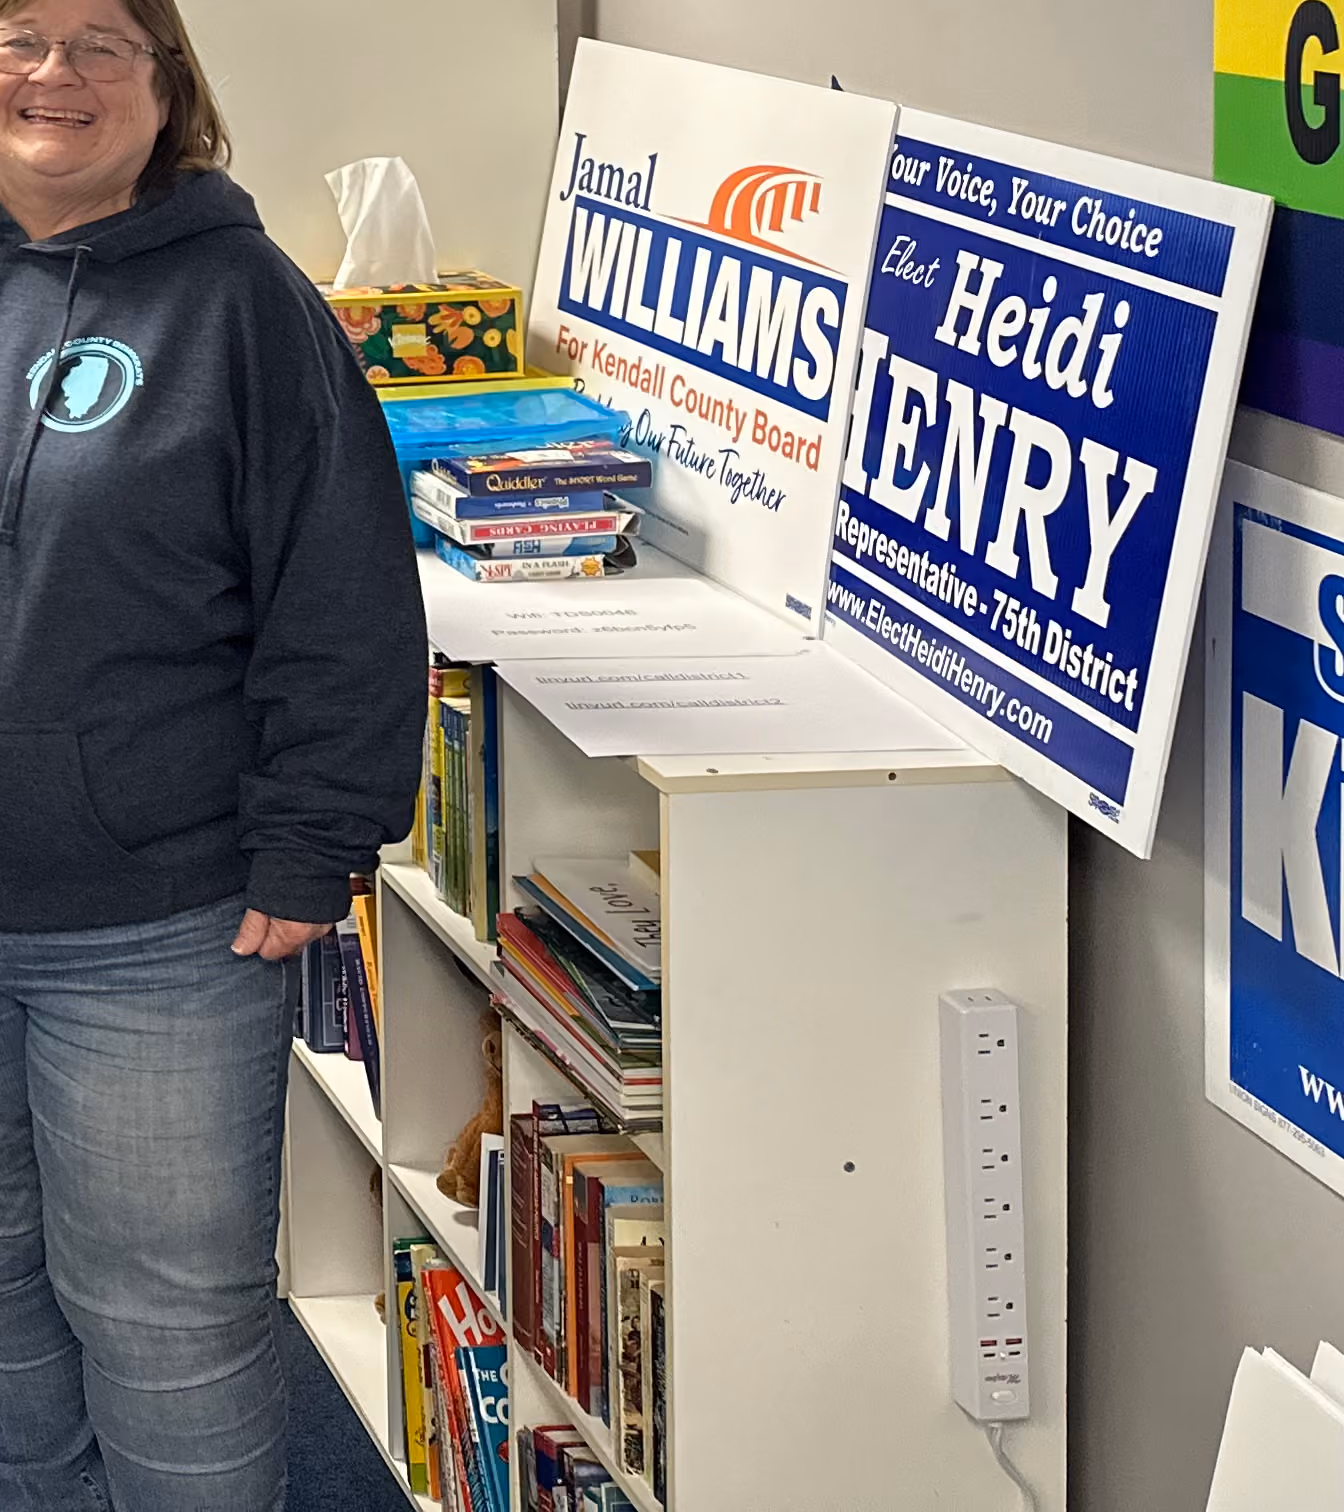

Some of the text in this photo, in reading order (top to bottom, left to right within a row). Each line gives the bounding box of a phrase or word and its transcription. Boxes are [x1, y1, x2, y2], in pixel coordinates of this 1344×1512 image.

[1284, 0, 1341, 166] G
[559, 132, 658, 212] Jamal
[935, 156, 998, 217] Voice,
[1008, 176, 1066, 227] Your
[1071, 194, 1163, 258] Choice
[881, 235, 940, 288] Elect
[63, 336, 113, 348] COUNTY
[569, 206, 839, 402] WILLIAMS
[935, 249, 1131, 409] Heidi
[556, 325, 588, 363] For
[591, 339, 666, 400] Kendall
[670, 374, 747, 443] County
[752, 409, 822, 472] Board
[486, 473, 547, 492] Quiddler
[635, 408, 665, 454] Our
[667, 424, 716, 480] Future
[719, 448, 787, 512] Together
[489, 520, 598, 538] PLAYING CARDS
[513, 539, 541, 554] FISH
[522, 561, 532, 569] IN
[532, 561, 540, 569] A
[541, 560, 570, 569] FLASH
[835, 500, 976, 618] Representative
[990, 588, 1038, 656] 75th
[1043, 619, 1139, 711] District
[827, 579, 1054, 744] www.ElectHeidiHenry.com
[438, 1281, 497, 1347] Ho
[475, 1367, 499, 1383] THE
